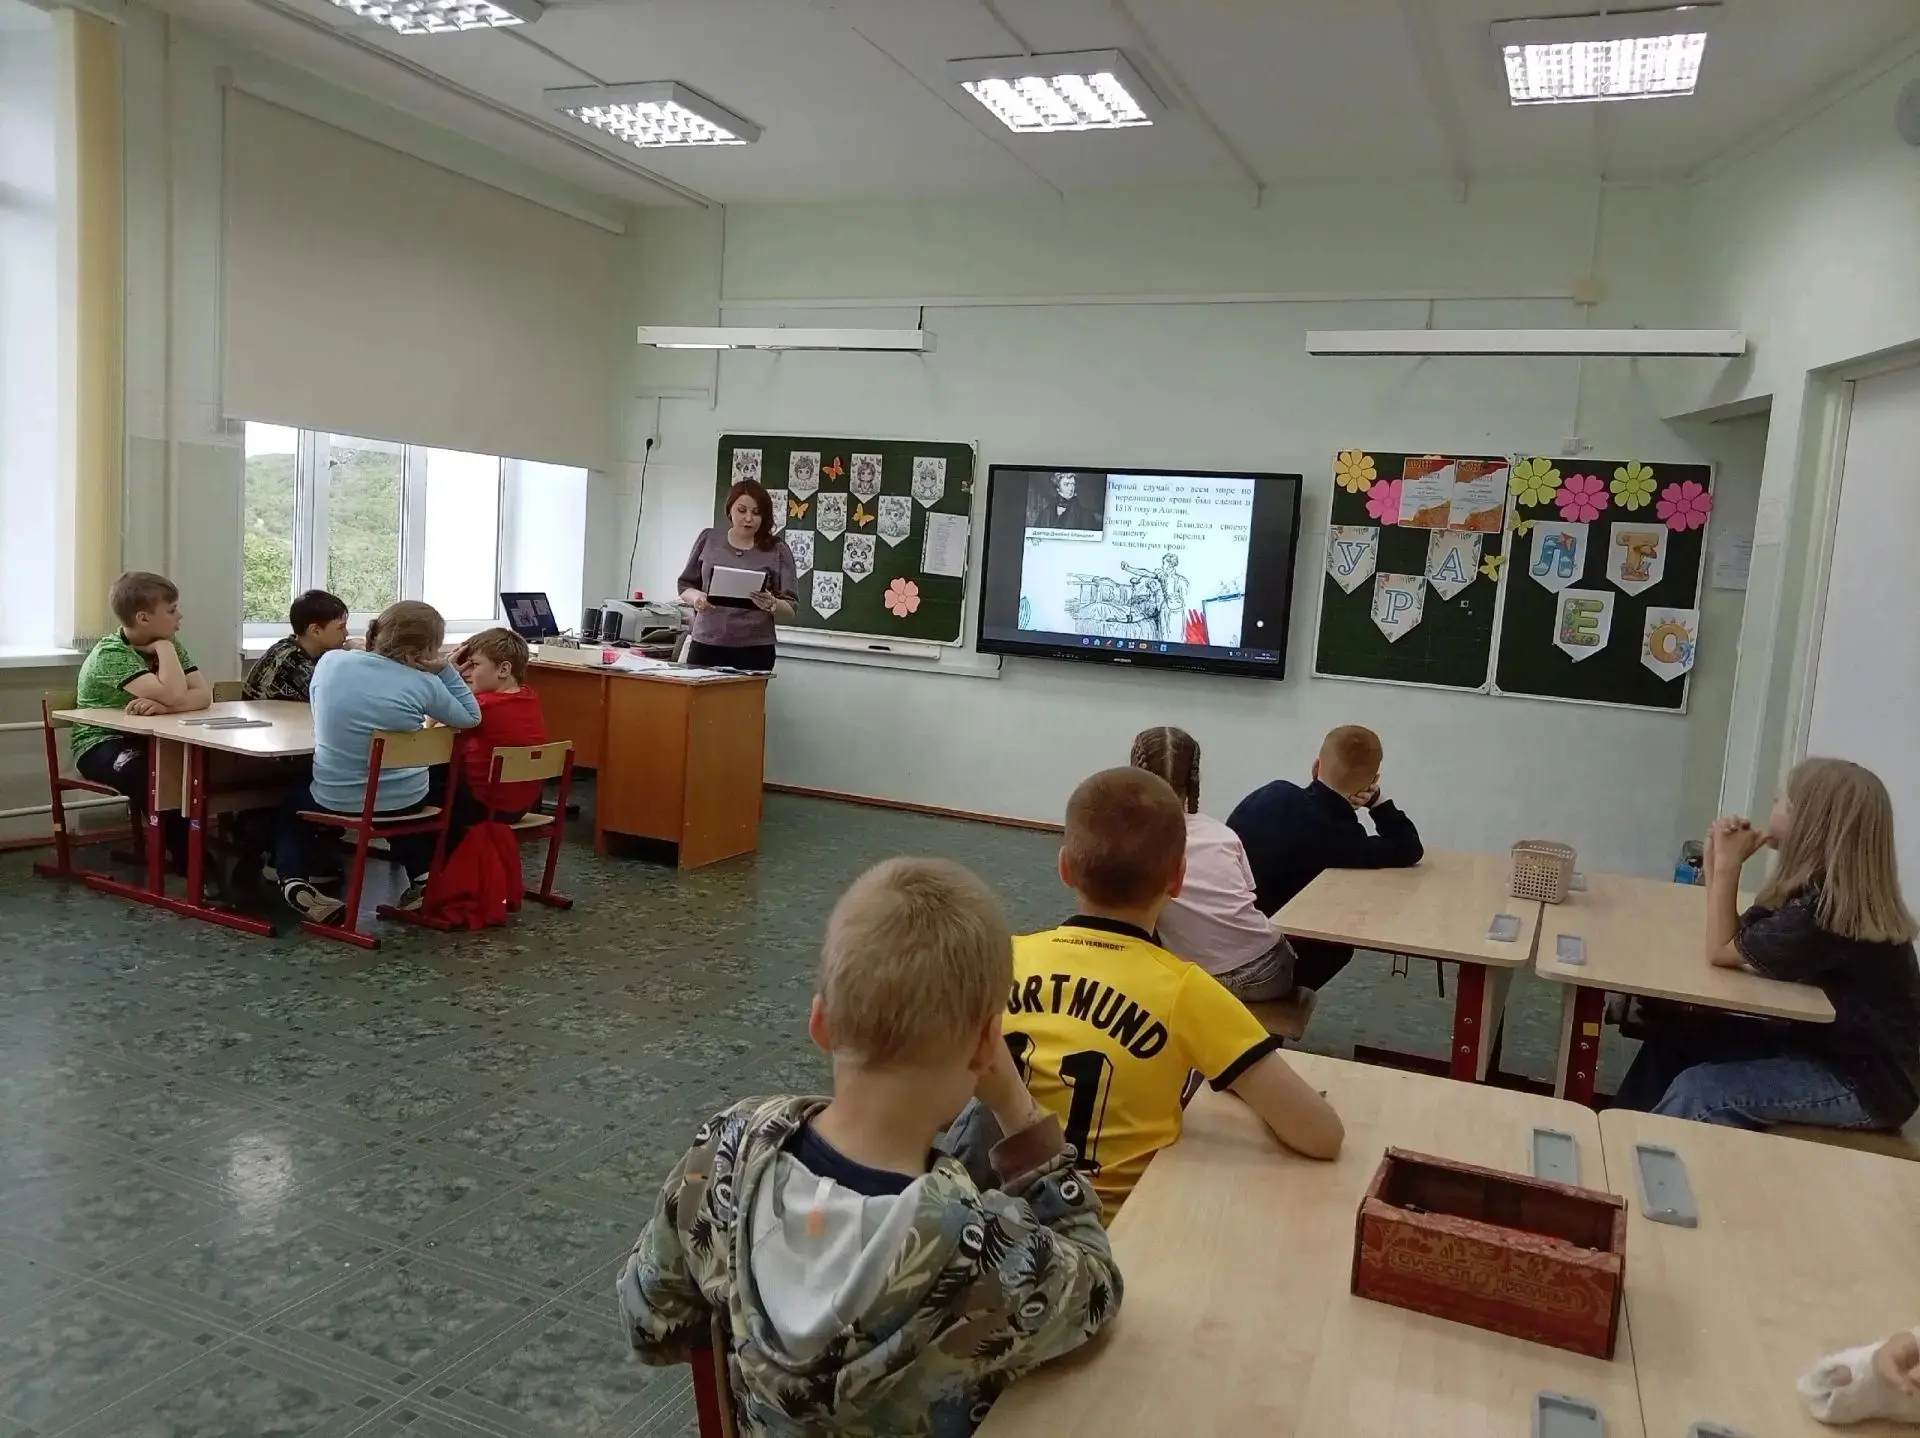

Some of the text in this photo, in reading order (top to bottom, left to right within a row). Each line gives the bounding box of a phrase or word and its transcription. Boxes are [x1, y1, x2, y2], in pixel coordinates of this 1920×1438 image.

[1108, 481, 1137, 492] Первый
[1143, 483, 1170, 494] случай
[1215, 487, 1236, 496] мире
[1115, 504, 1132, 513] 1818
[1134, 507, 1150, 515] году
[1104, 517, 1132, 527] Доктор
[1232, 534, 1248, 543] 500
[1084, 939, 1125, 952] VERBINDET
[1006, 974, 1168, 1059] ORTMUND
